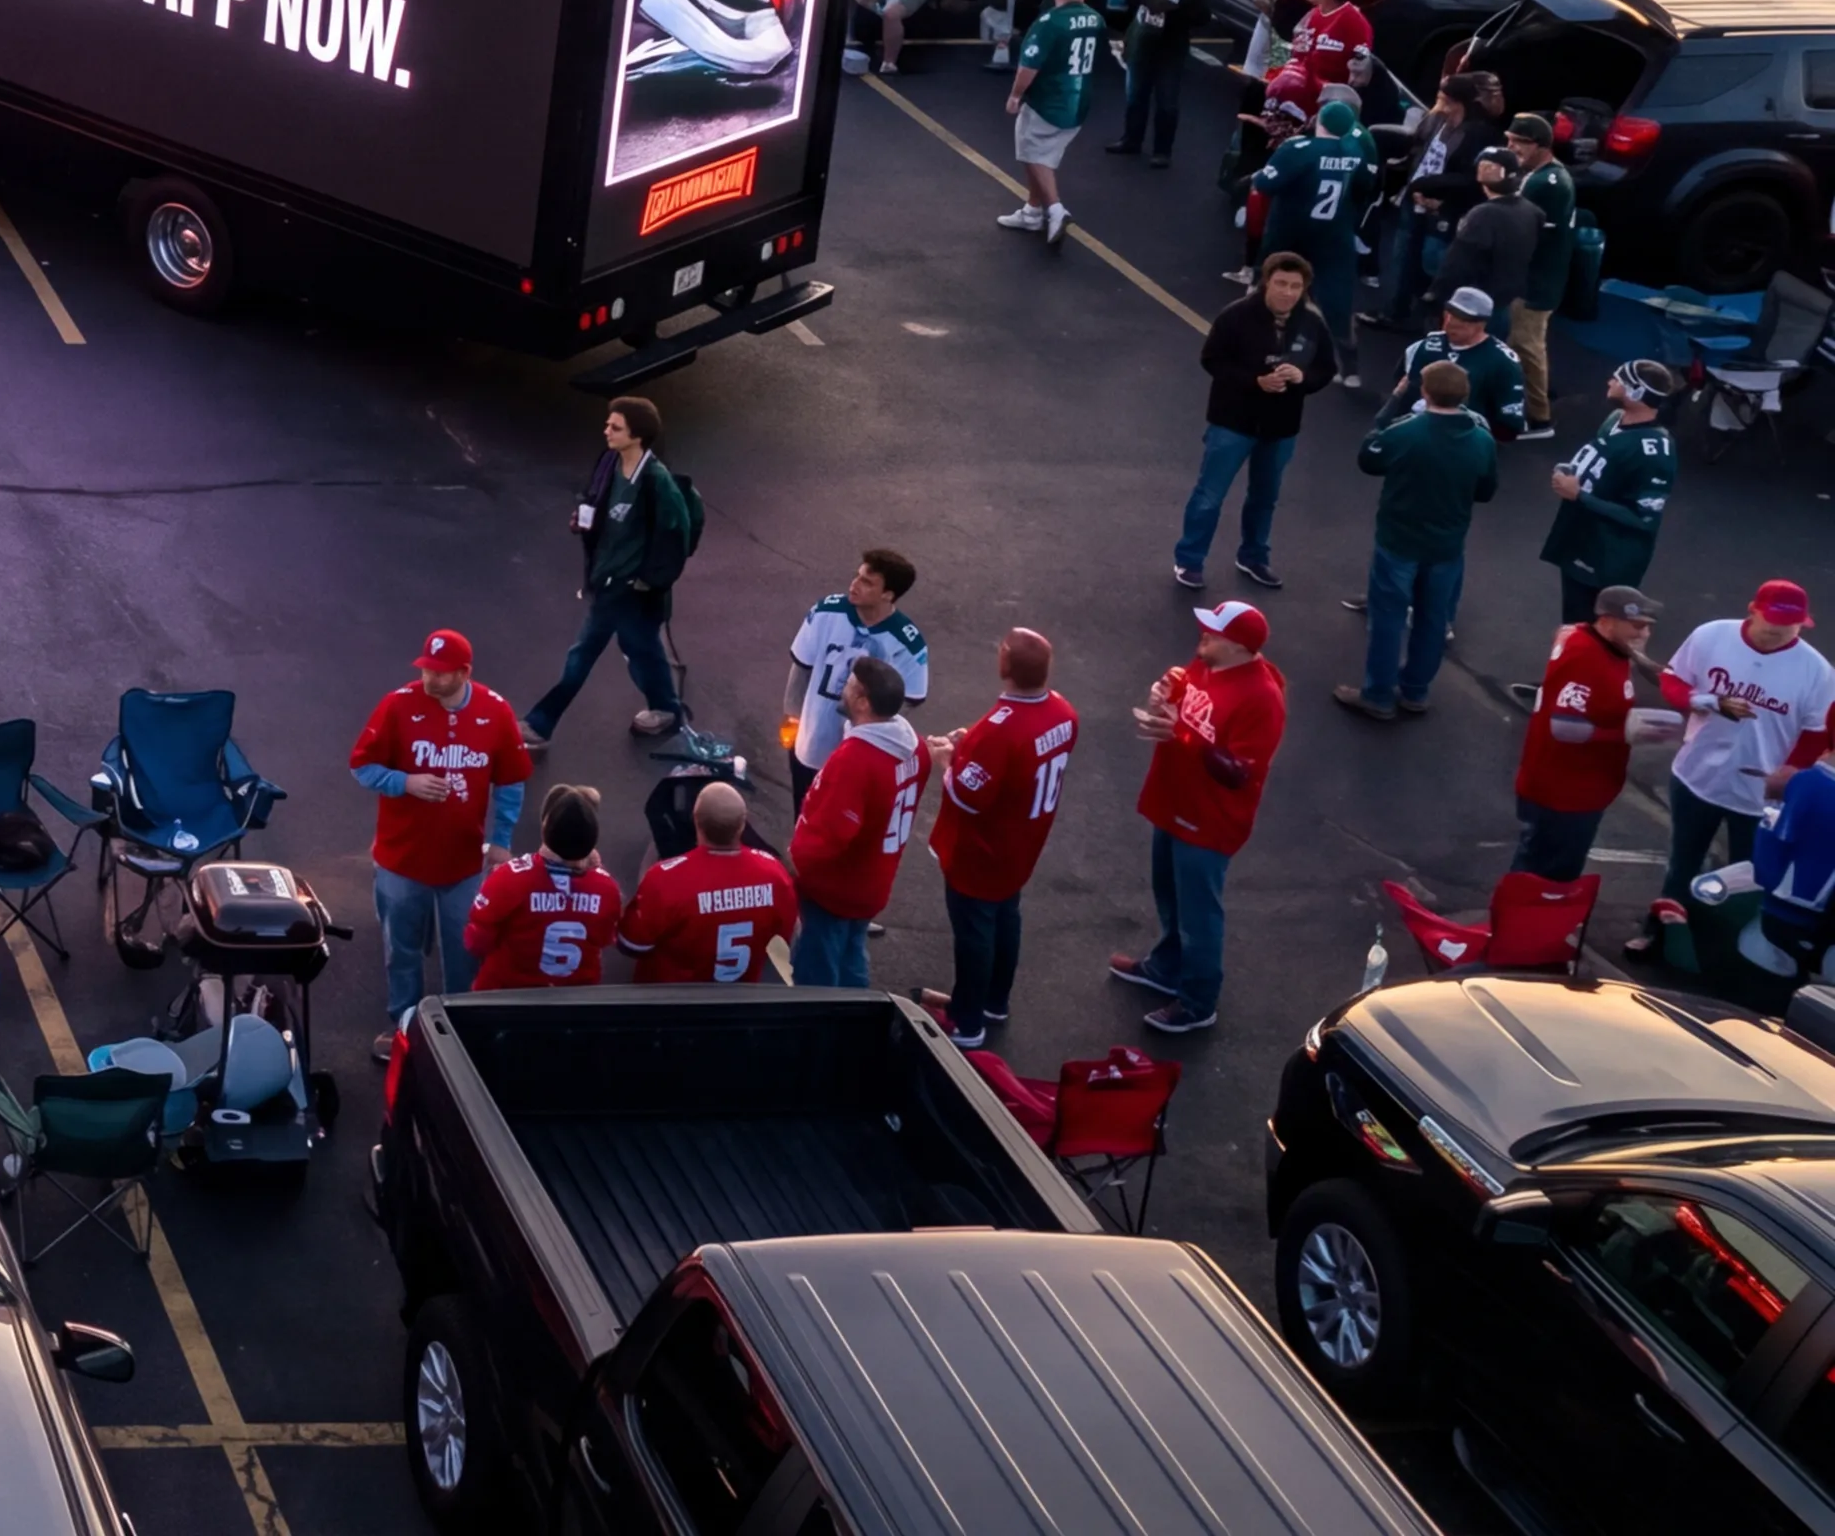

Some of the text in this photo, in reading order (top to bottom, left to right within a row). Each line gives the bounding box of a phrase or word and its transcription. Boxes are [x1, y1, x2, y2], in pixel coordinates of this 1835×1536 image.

[1310, 179, 1343, 221] 2
[539, 921, 587, 978] 6
[714, 921, 754, 983] 5
